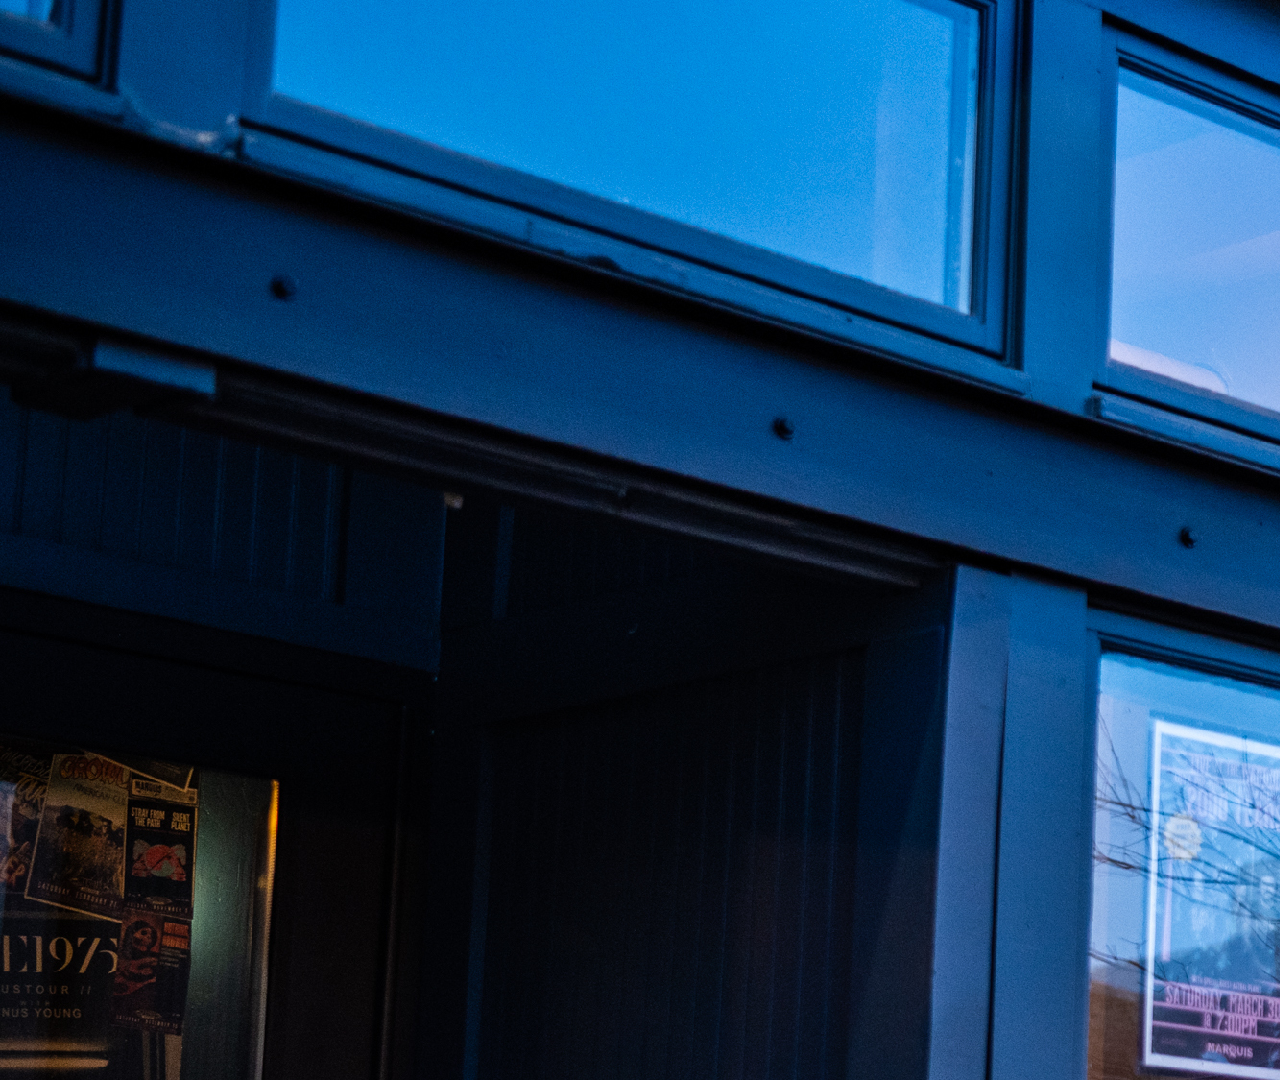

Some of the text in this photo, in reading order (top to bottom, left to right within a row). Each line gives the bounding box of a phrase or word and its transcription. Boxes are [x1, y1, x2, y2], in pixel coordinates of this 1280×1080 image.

[35, 1008, 83, 1019] YOUNG
[1229, 994, 1264, 1018] MARCH
[1216, 1014, 1258, 1037] 7:00PM
[1206, 1042, 1254, 1059] MARQUIS
